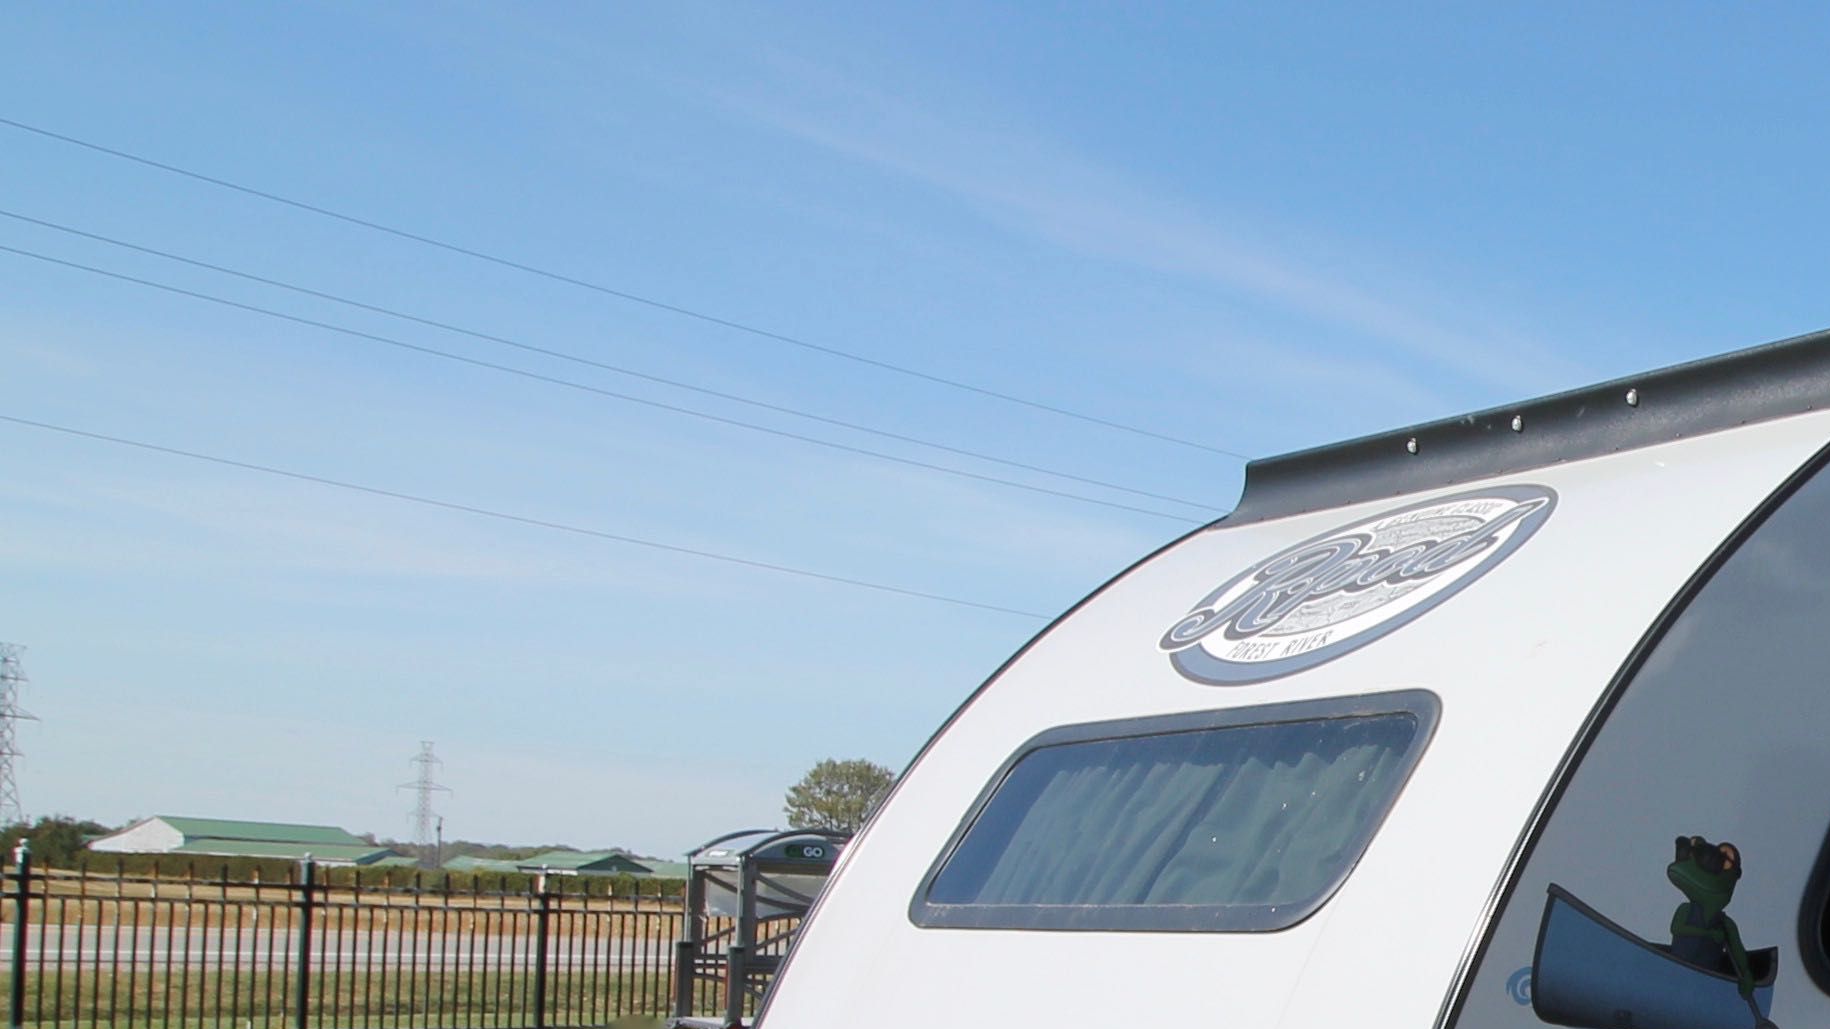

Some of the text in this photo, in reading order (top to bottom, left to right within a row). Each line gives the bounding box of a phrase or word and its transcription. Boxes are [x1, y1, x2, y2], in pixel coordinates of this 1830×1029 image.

[1226, 630, 1334, 660] FOREST RIVER
[803, 846, 823, 858] GO
